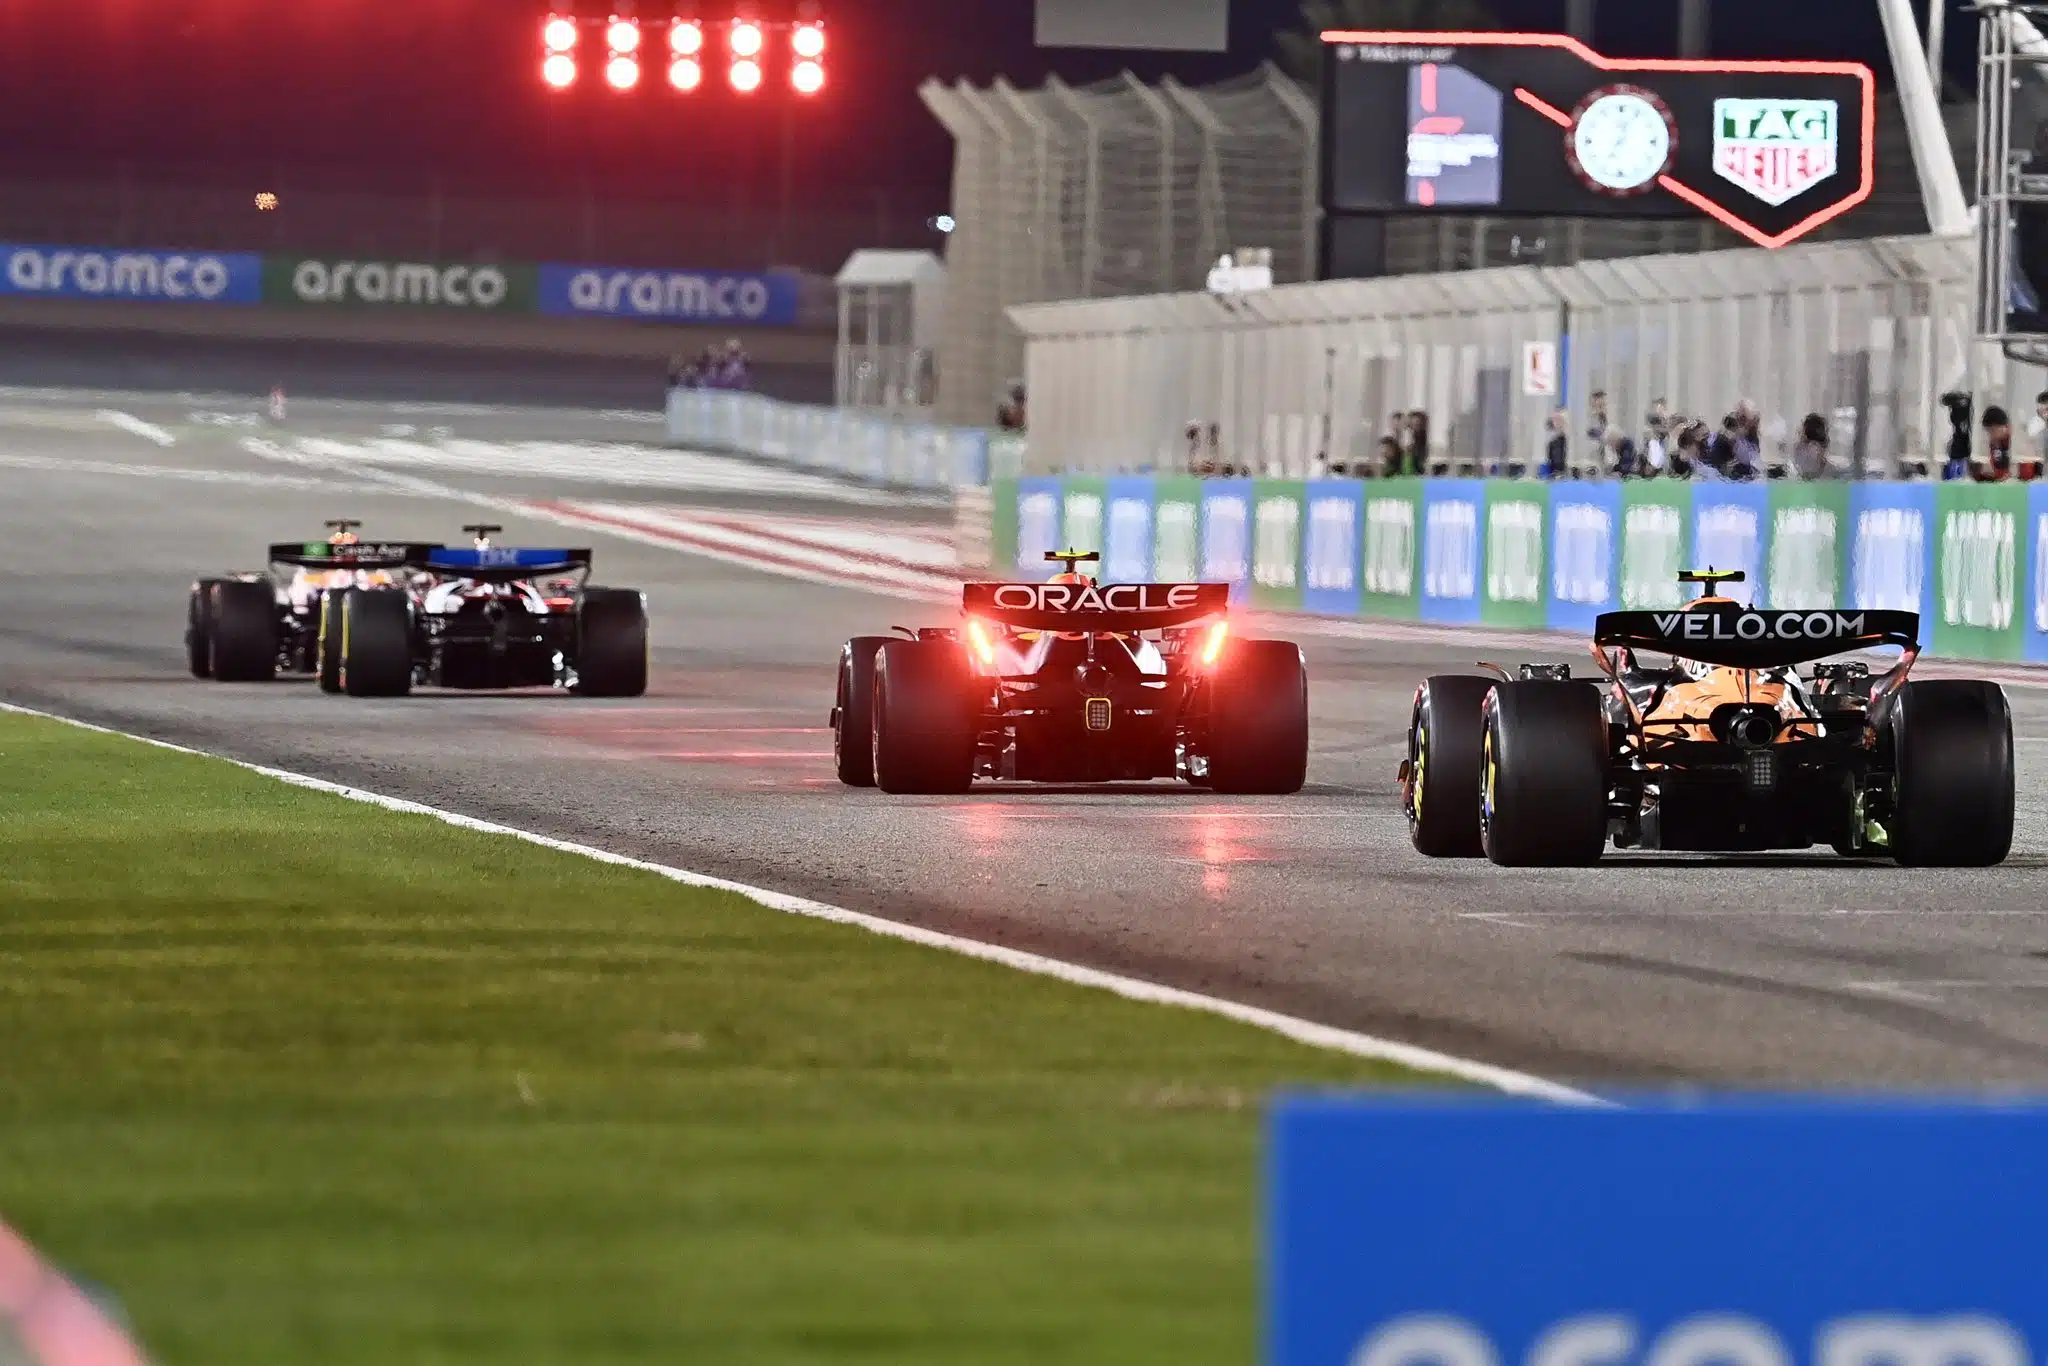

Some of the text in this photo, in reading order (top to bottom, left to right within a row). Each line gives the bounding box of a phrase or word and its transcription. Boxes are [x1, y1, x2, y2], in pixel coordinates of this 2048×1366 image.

[1723, 108, 1824, 139] TAG
[9, 249, 229, 298] aramco
[293, 260, 507, 307] aramco
[568, 270, 769, 318] aramco
[993, 584, 1200, 612] ORACLE
[1652, 612, 1865, 640] VELO.COM
